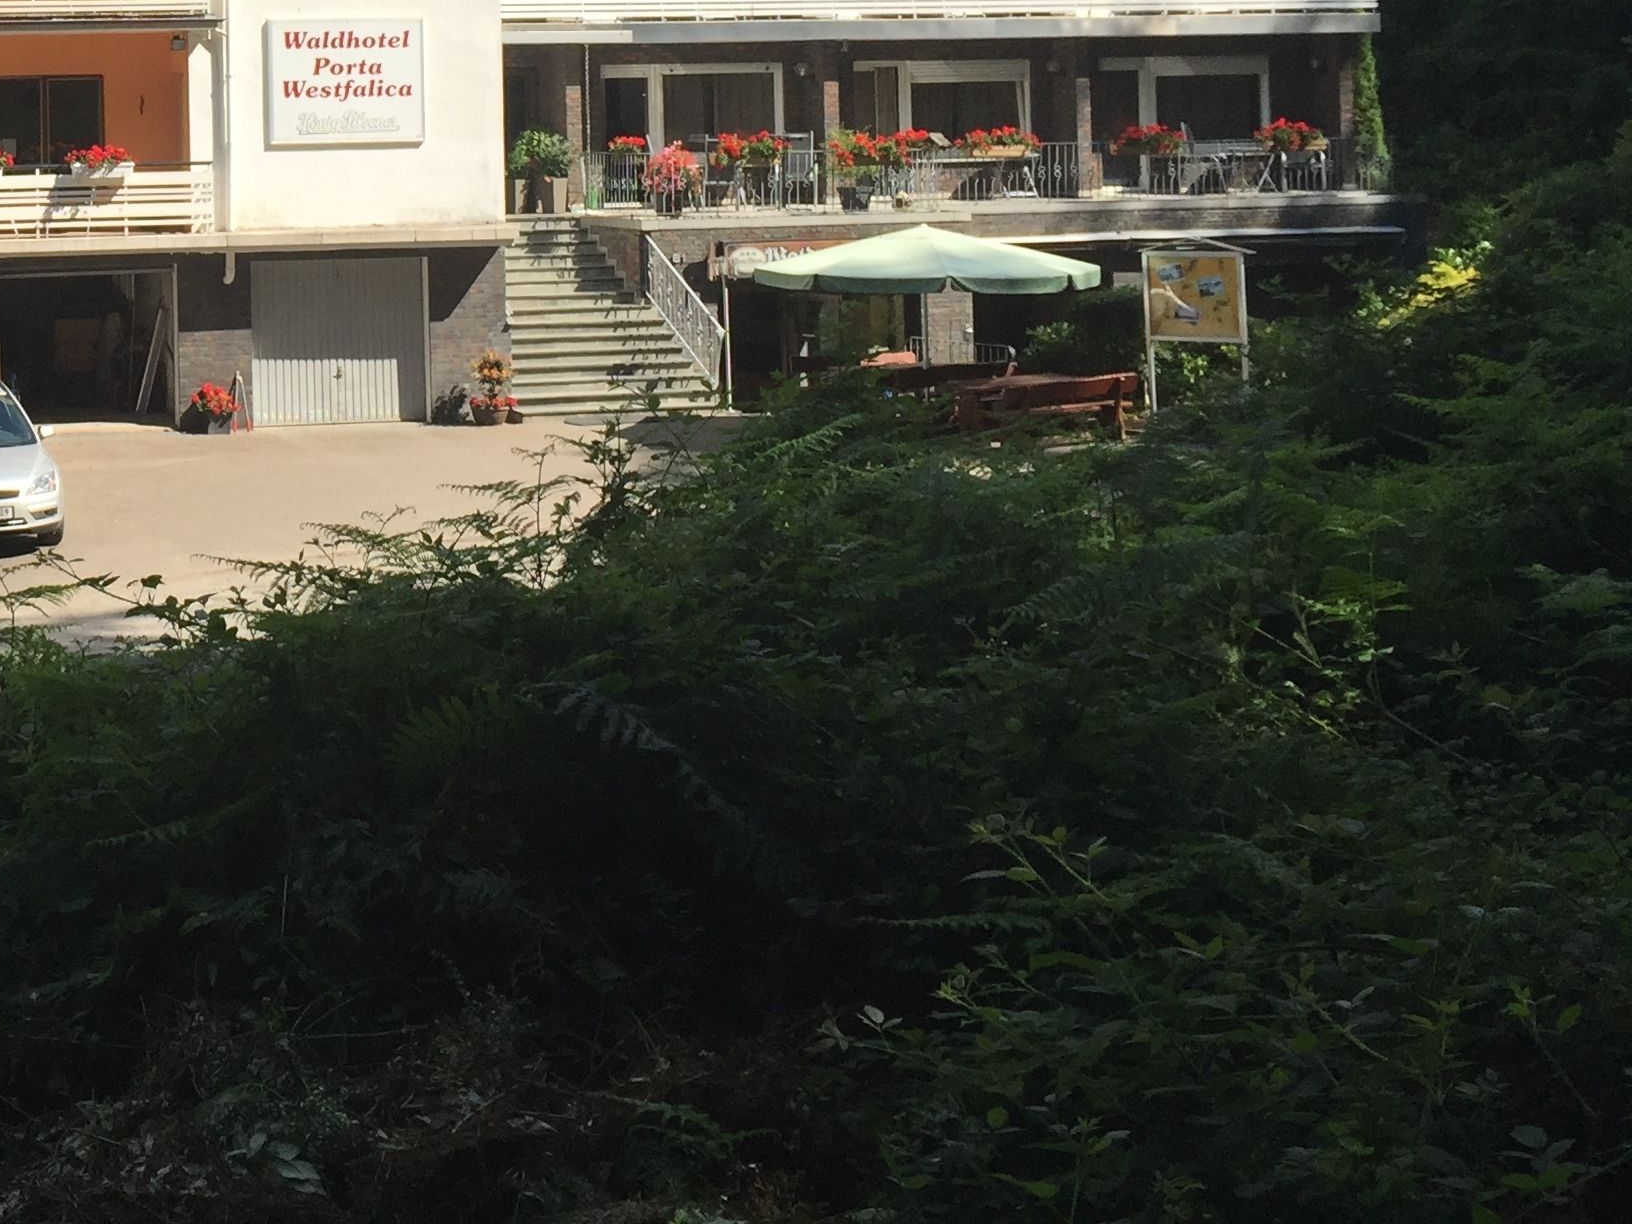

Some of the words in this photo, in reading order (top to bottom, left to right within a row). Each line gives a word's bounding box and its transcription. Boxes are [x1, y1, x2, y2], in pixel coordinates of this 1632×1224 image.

[284, 31, 410, 49] Waldhotel
[313, 58, 382, 75] Porta
[283, 80, 412, 102] Westfalica
